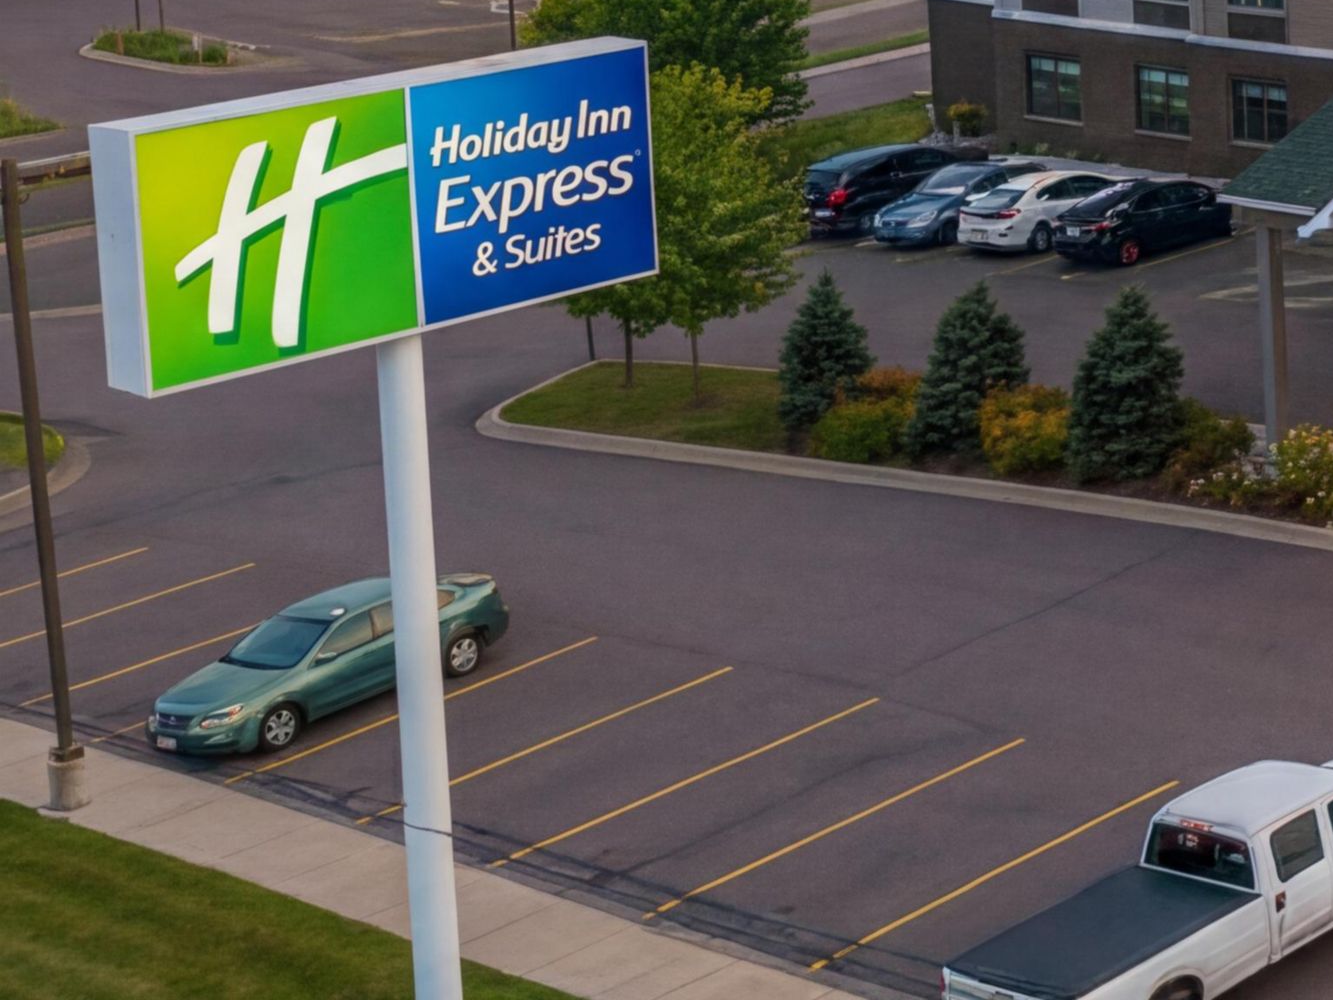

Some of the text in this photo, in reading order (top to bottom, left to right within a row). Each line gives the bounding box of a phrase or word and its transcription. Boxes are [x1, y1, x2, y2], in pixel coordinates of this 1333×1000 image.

[429, 99, 632, 168] Holiday Inn
[434, 154, 635, 235] Express
[472, 223, 602, 277] & Suites
